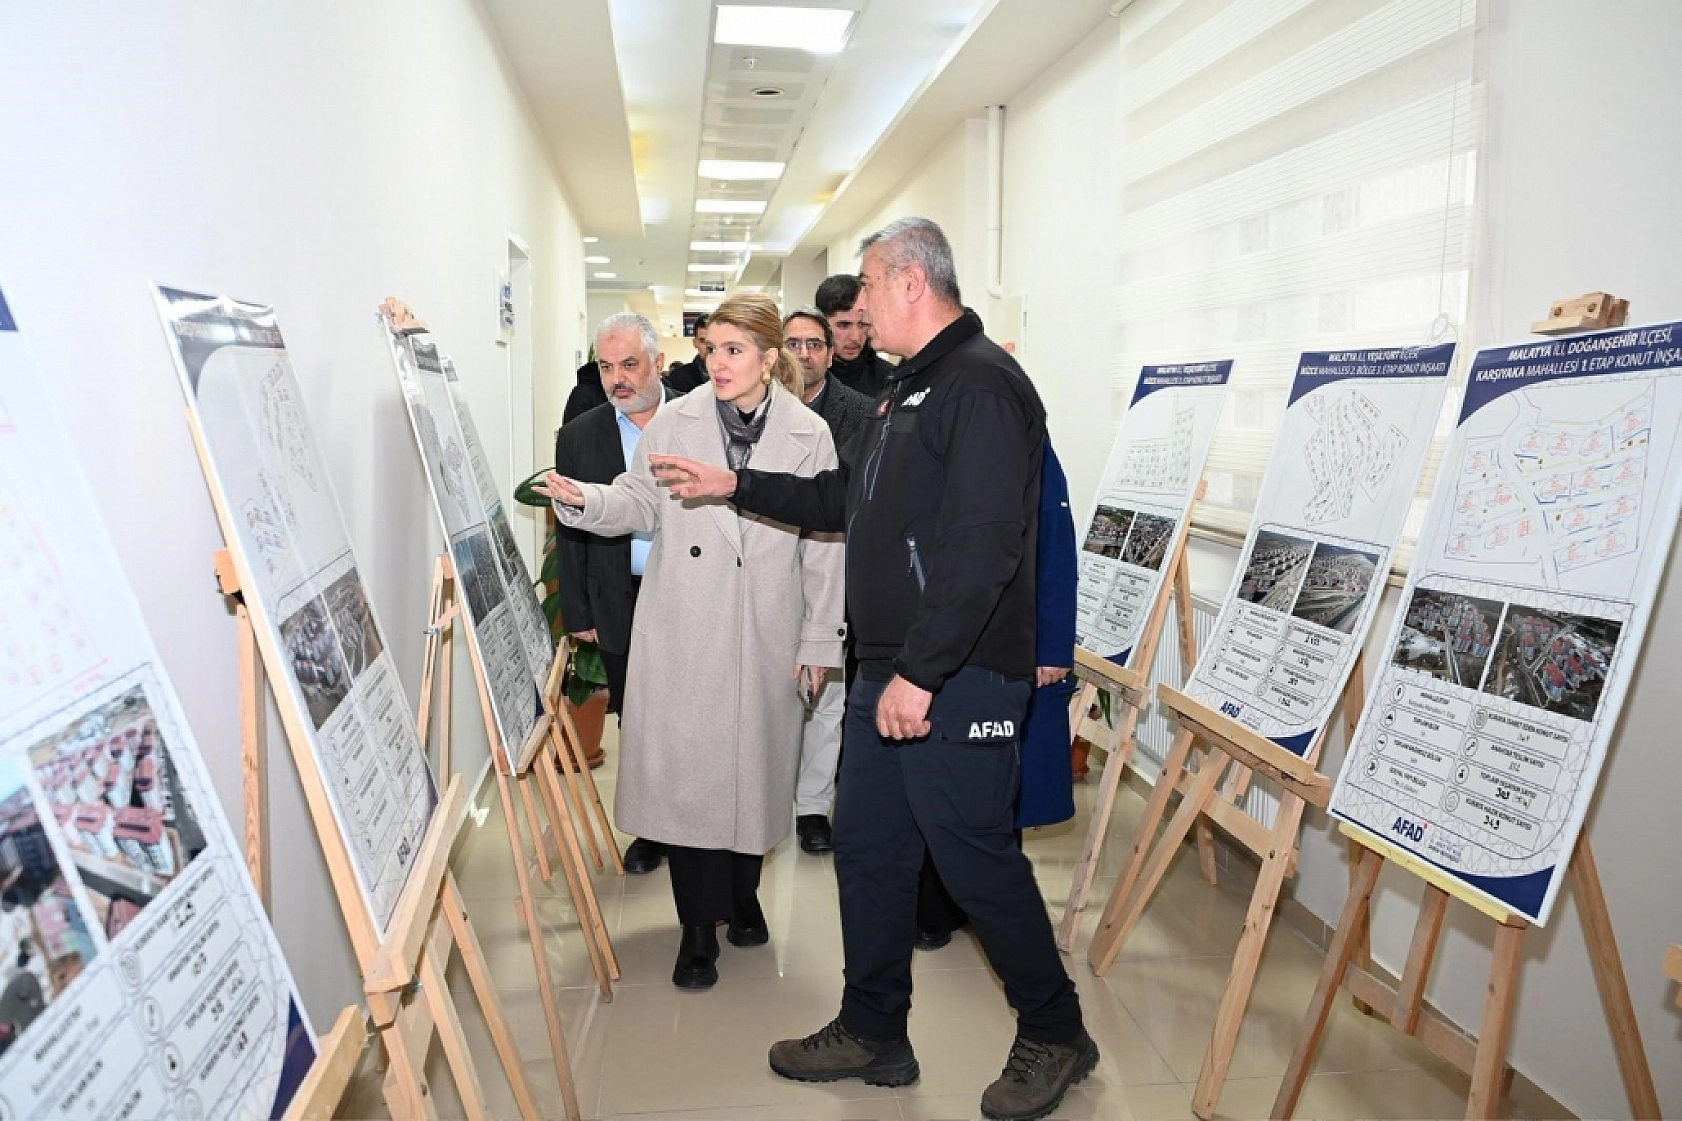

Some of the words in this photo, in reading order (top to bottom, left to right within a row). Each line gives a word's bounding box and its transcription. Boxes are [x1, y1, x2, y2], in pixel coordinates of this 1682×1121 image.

[1507, 345, 1552, 361] MALATYA
[1567, 331, 1639, 354] DOĞANŞEHİR
[1476, 366, 1525, 382] KARŞIYAKA
[1588, 356, 1615, 371] ETAP
[1615, 351, 1654, 368] KONUT
[968, 720, 1015, 739] AFAD
[1391, 817, 1424, 842] AFAD
